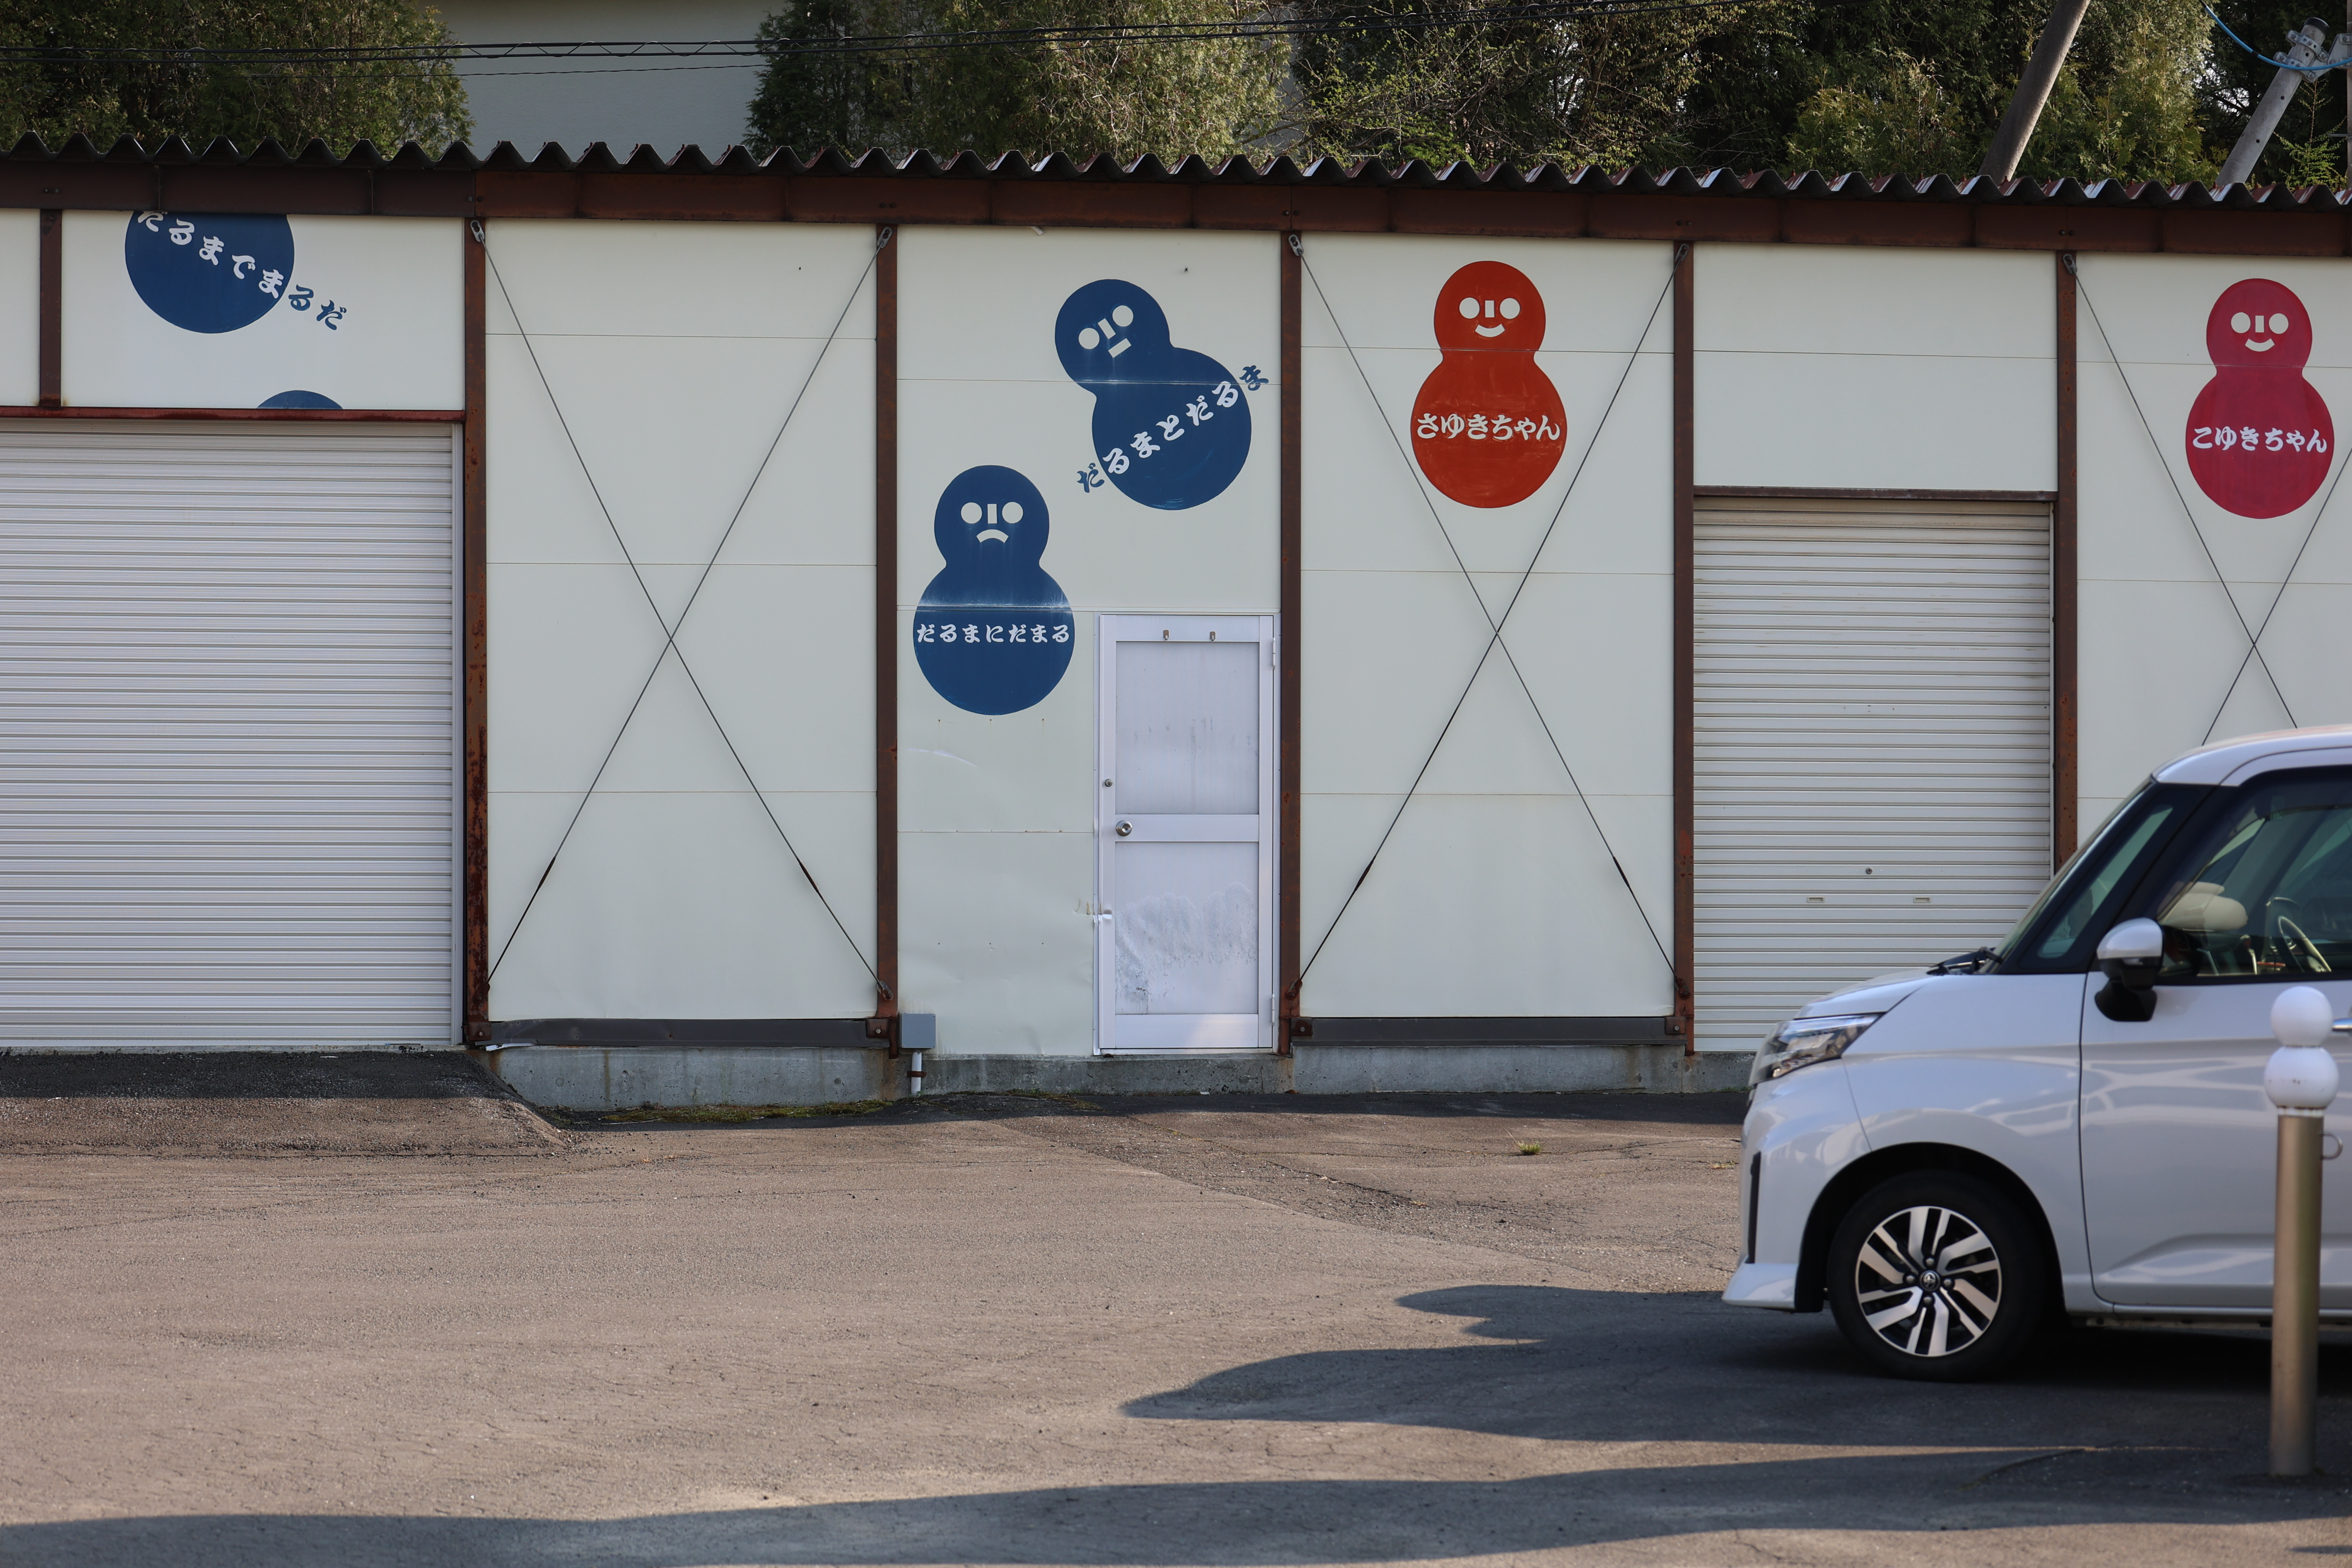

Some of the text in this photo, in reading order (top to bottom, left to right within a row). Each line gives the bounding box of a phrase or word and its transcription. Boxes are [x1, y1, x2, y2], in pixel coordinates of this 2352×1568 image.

[1076, 364, 1269, 493] だるまとだるま
[1417, 413, 1561, 441] さゆきちゃん
[2193, 426, 2328, 453] こゆきちゃん
[916, 624, 1069, 643] だるまにだまる
